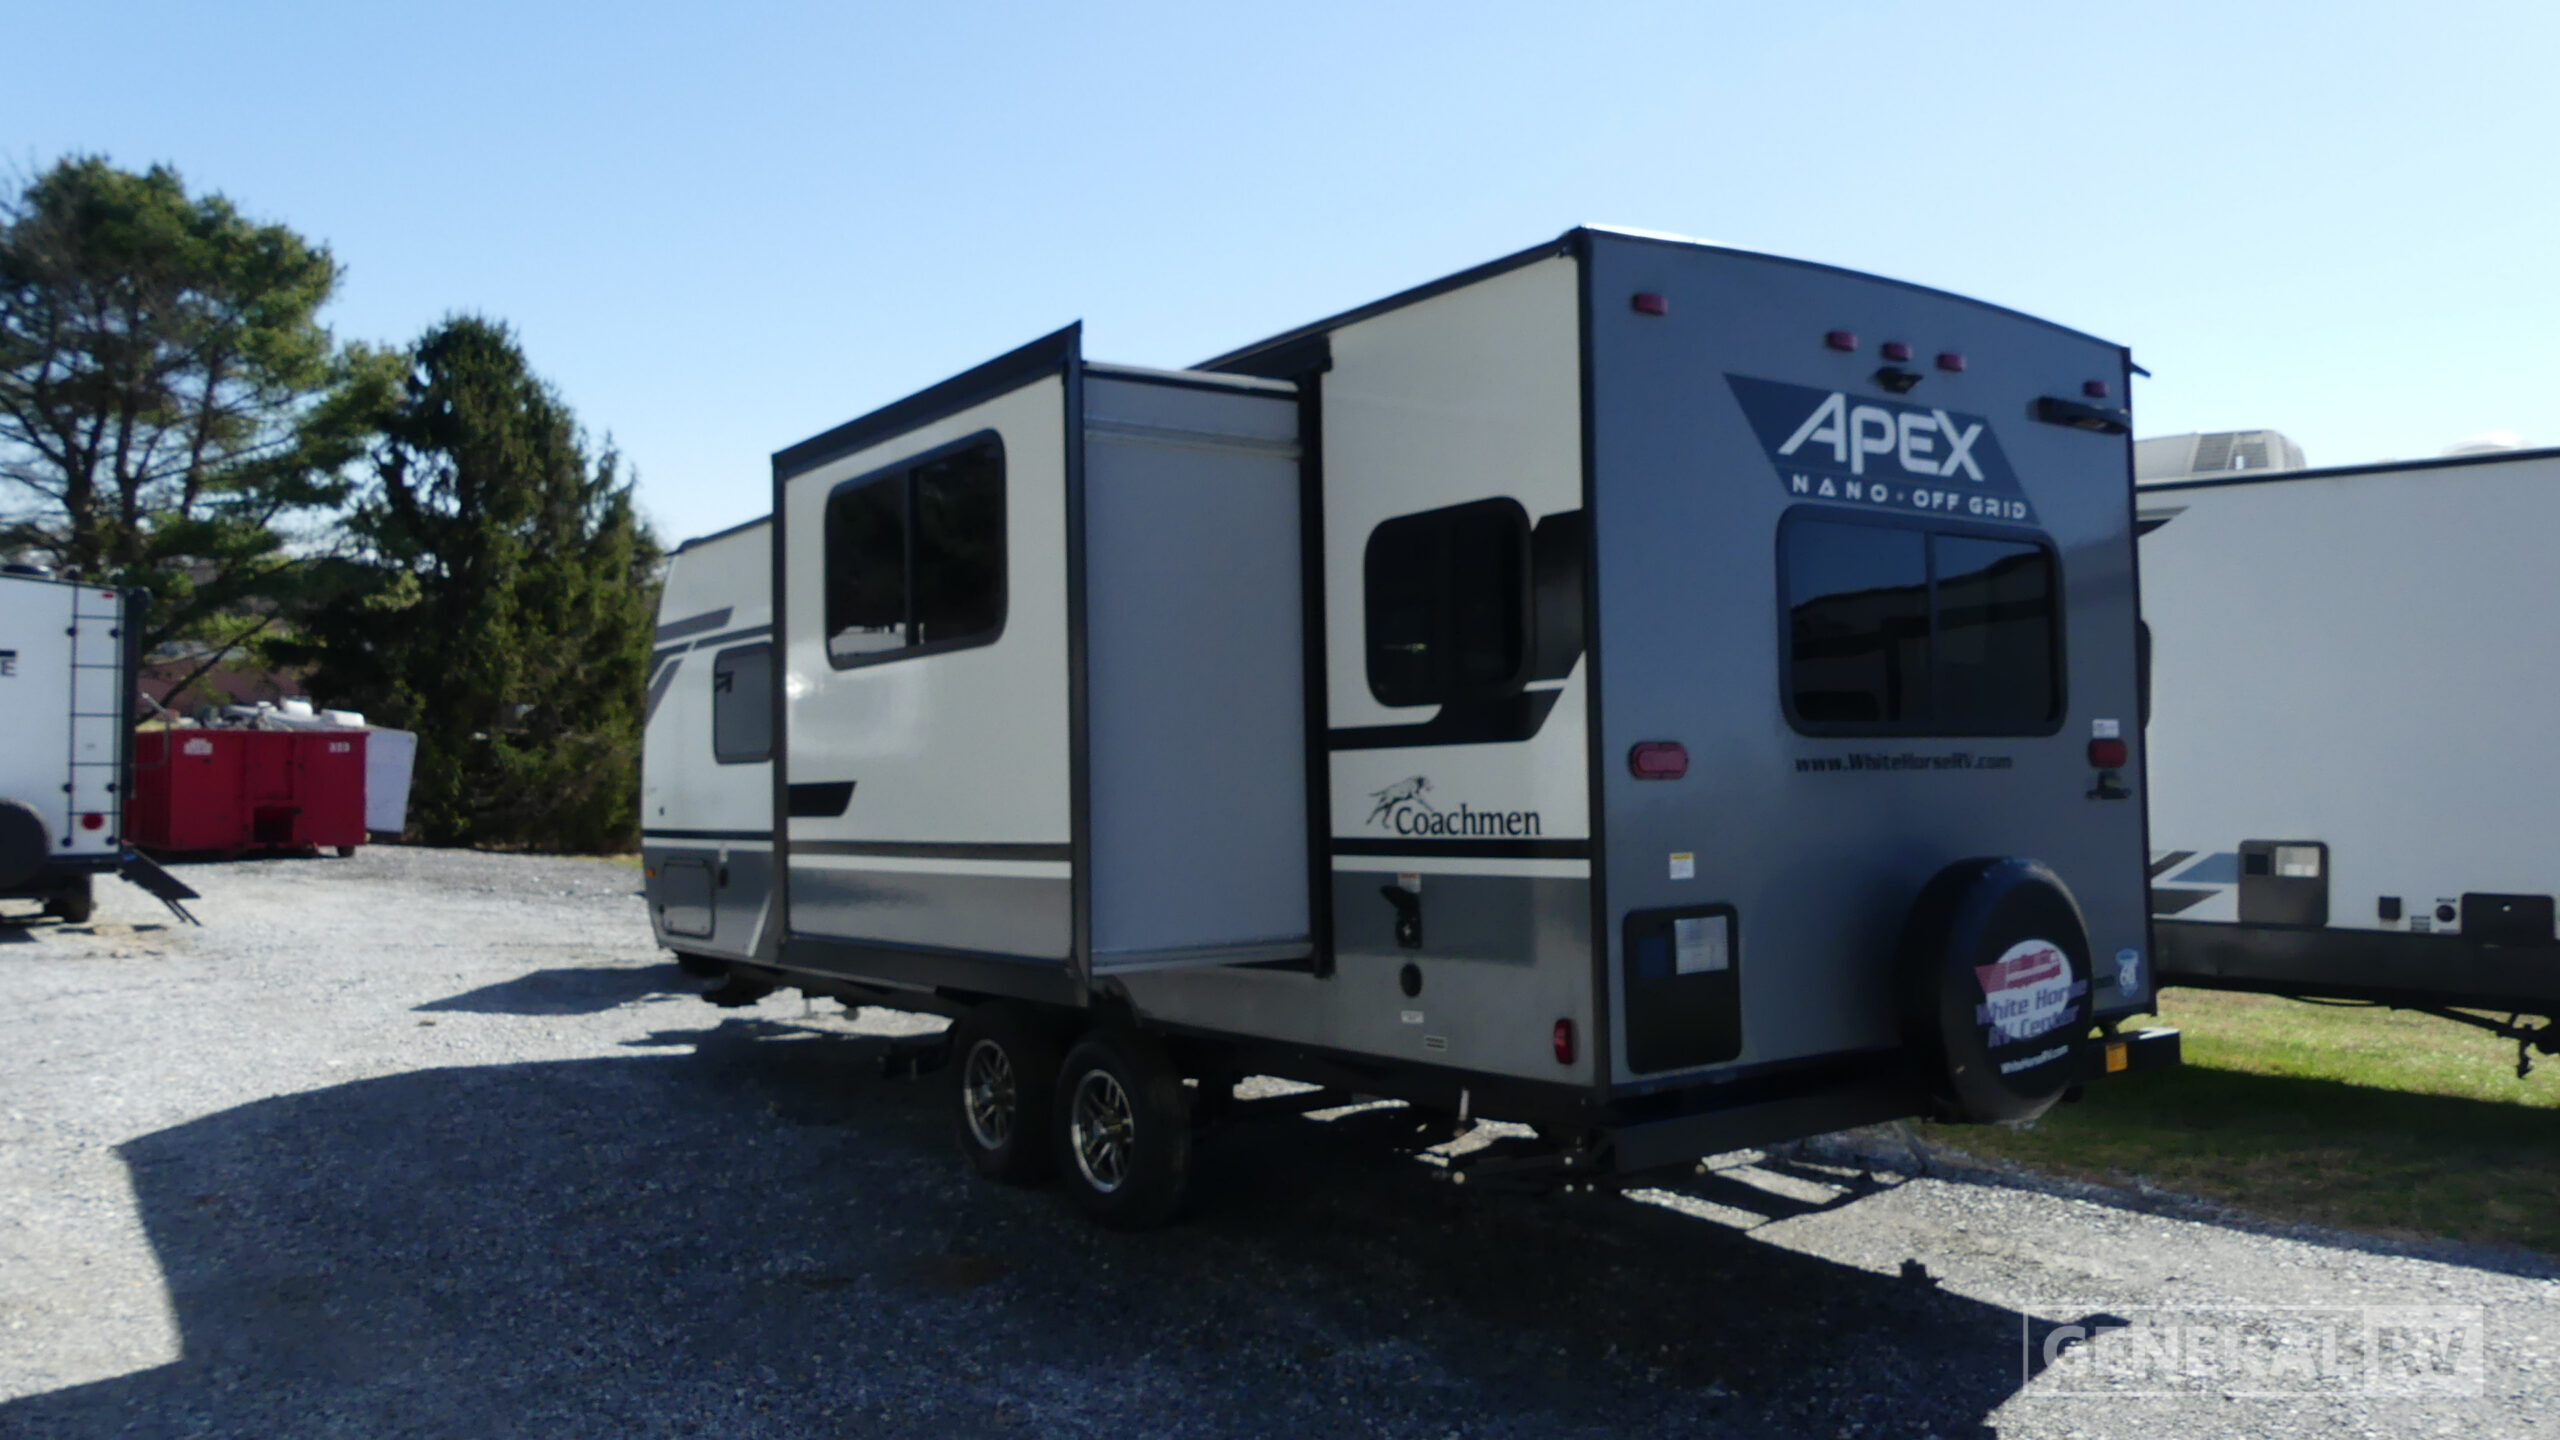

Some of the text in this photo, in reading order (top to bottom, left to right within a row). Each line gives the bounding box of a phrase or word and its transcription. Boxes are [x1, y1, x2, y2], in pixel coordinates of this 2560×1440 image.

[1777, 391, 1985, 482] APEX
[1793, 473, 2027, 519] NANO OFF GRID
[1395, 802, 1542, 836] Coachmen
